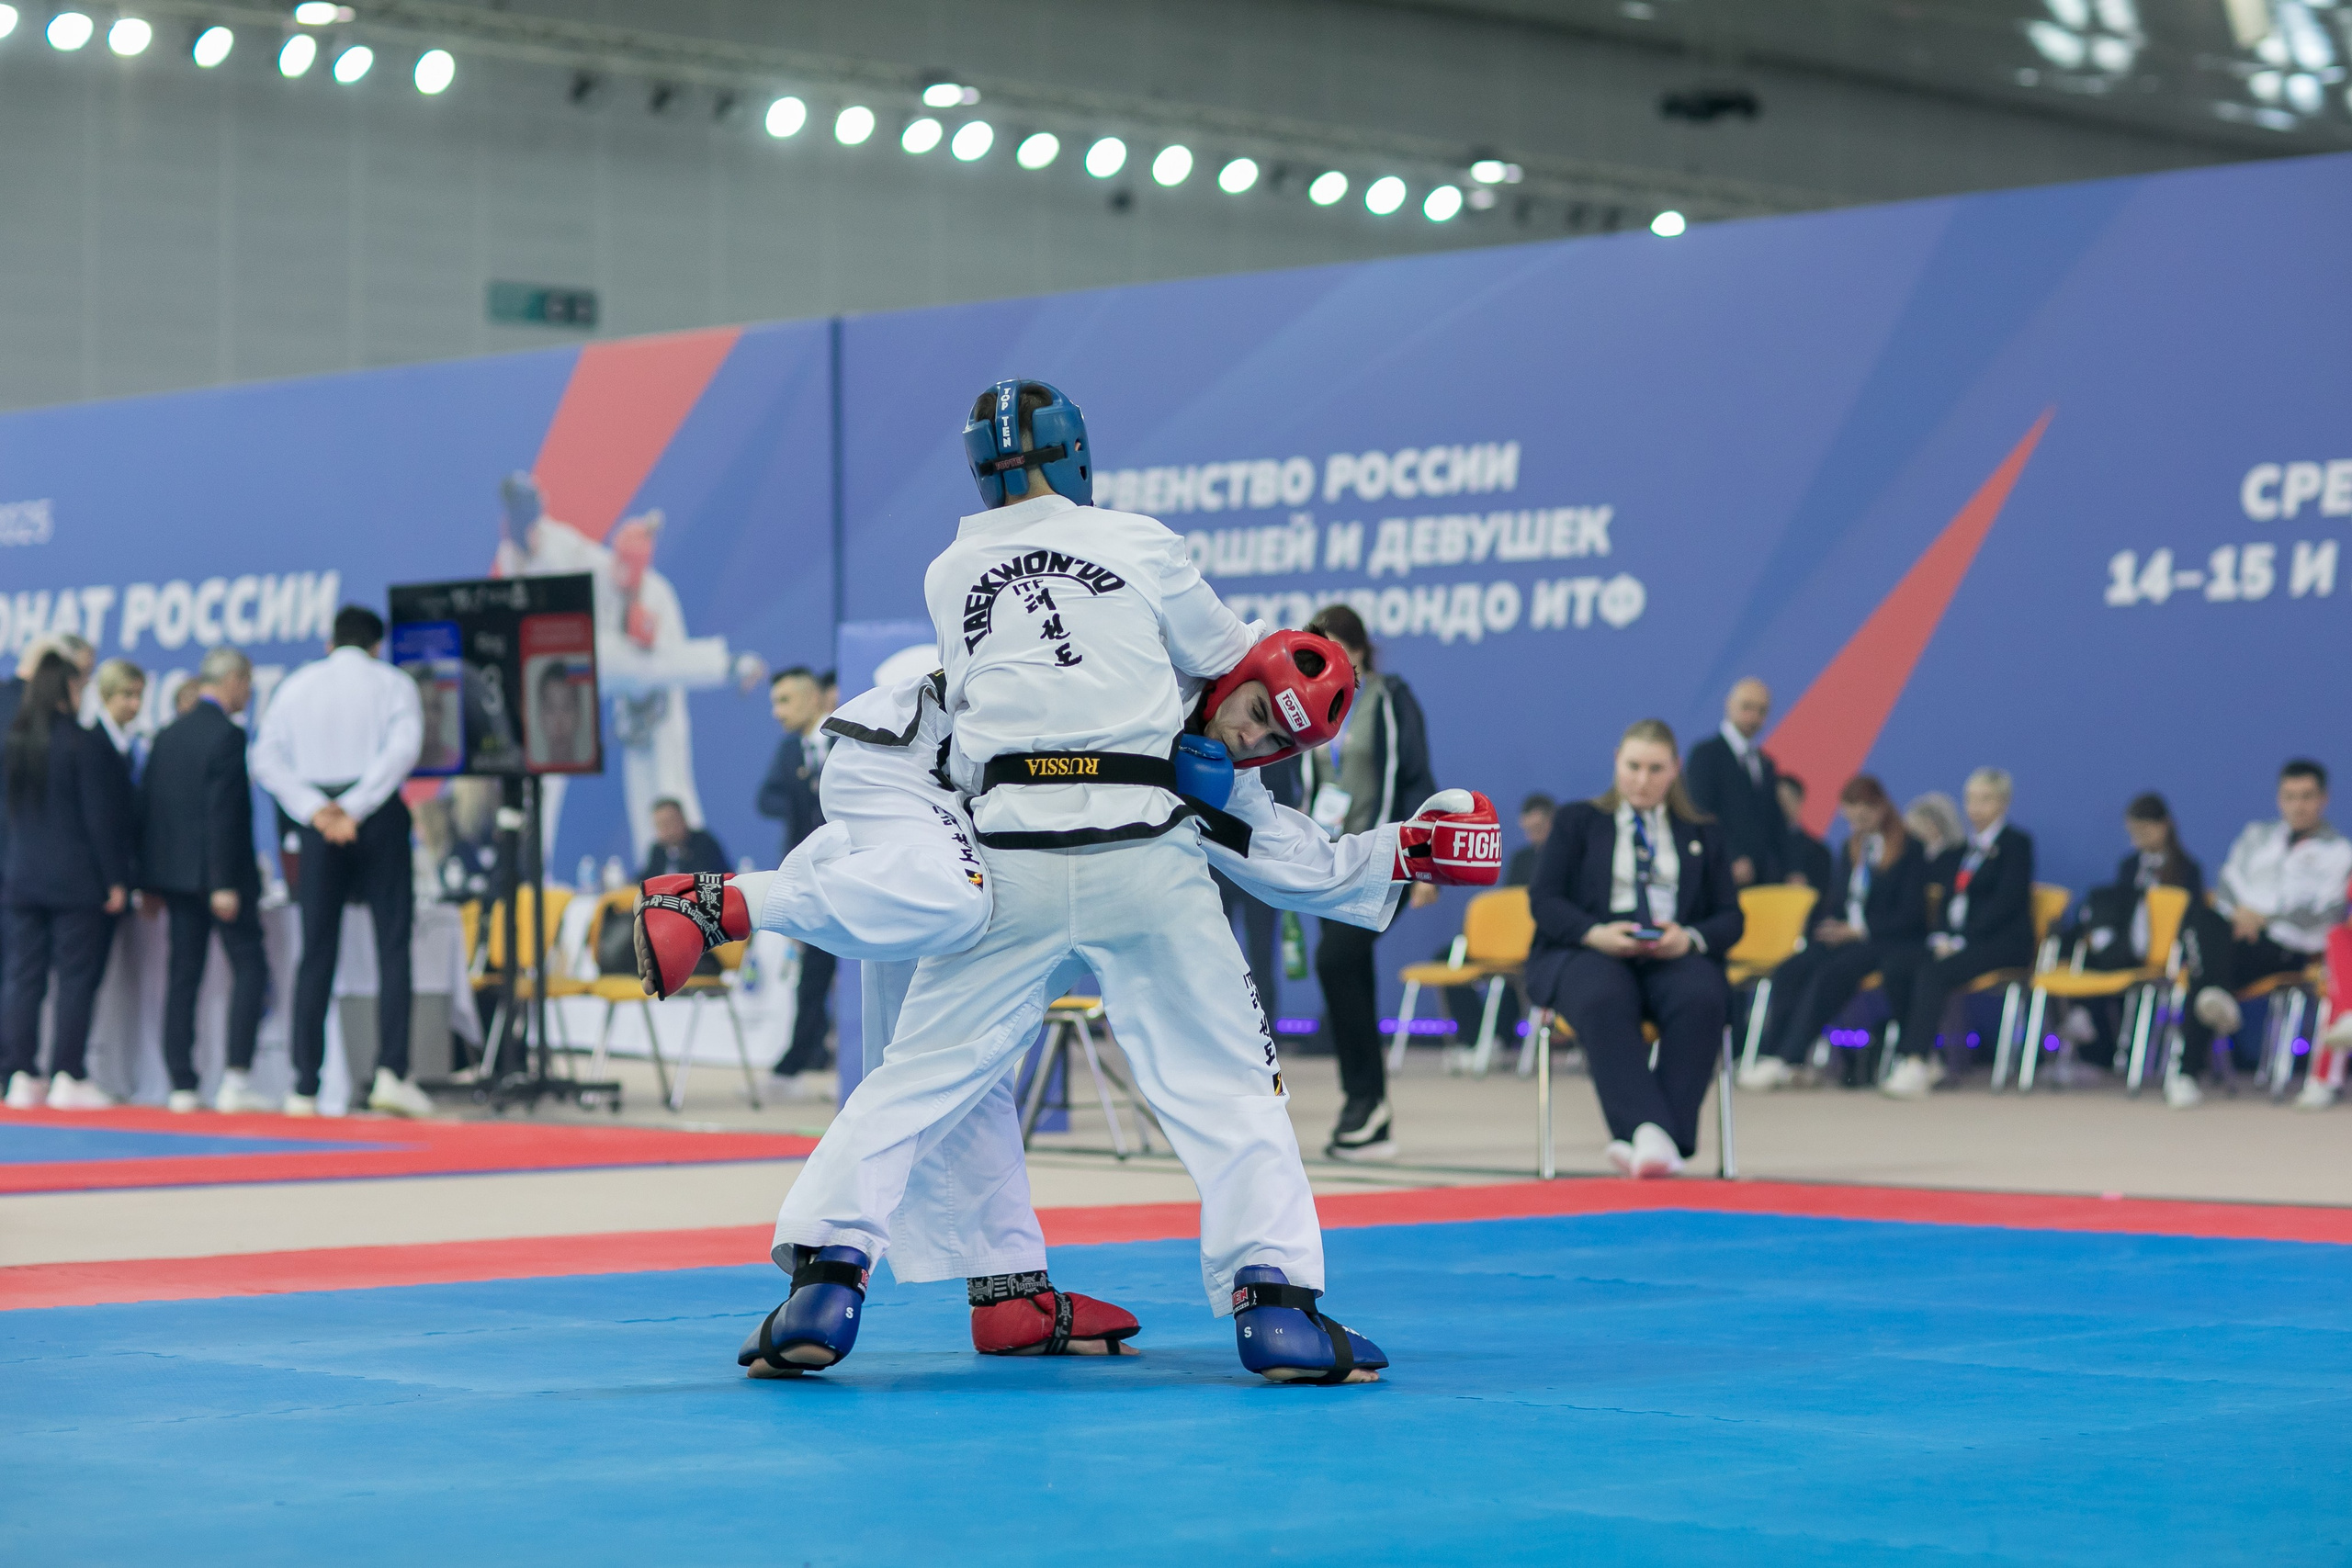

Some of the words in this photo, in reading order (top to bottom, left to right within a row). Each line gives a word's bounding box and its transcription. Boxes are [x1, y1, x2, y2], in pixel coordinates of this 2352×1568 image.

[1001, 388, 1011, 411] TOP
[1001, 416, 1012, 447] TEN
[1323, 441, 1521, 502] РОССИИ
[1325, 520, 1363, 570] И
[1367, 504, 1614, 579] ДЕВУШЕК
[2288, 538, 2339, 598] И
[1012, 579, 1044, 596] ITF
[1530, 570, 1647, 631] ИТФ
[0, 583, 118, 656] НАТ
[119, 570, 341, 650] РОССИИ
[1282, 694, 1296, 711] TOP
[1292, 711, 1306, 728] TEN
[1024, 757, 1101, 776] RUSSIA
[845, 1306, 854, 1319] S
[1243, 1326, 1252, 1338] S
